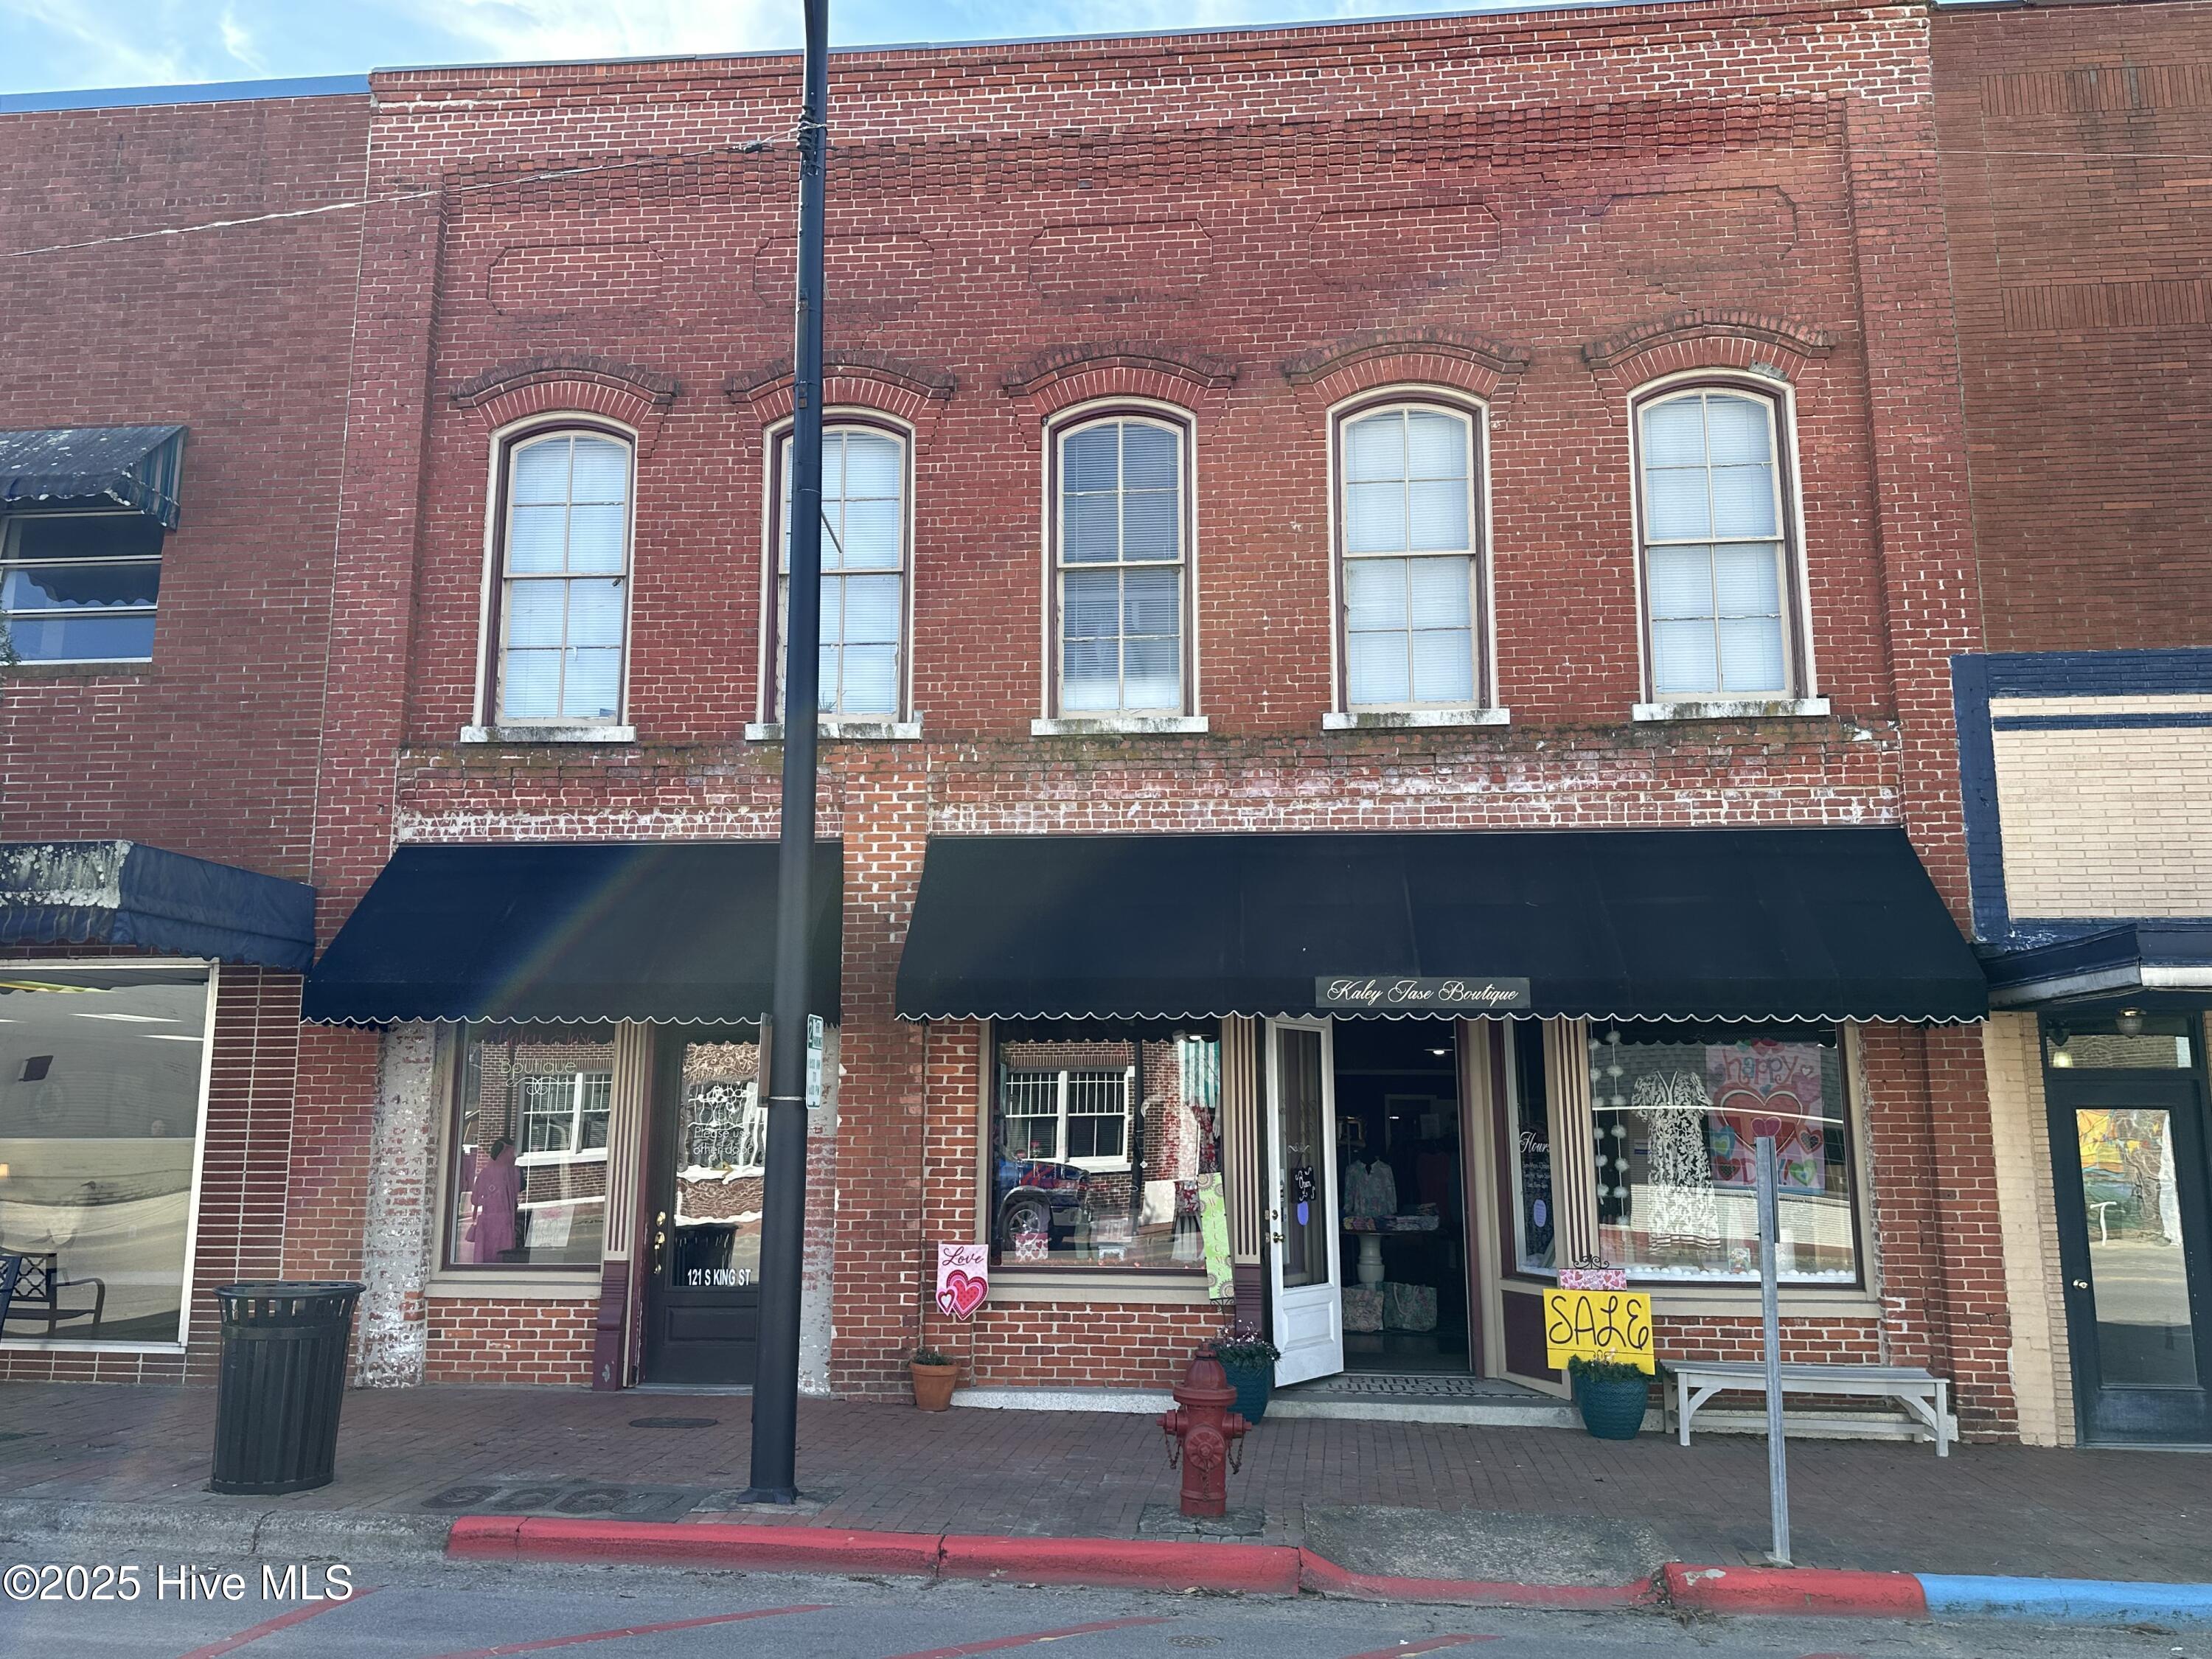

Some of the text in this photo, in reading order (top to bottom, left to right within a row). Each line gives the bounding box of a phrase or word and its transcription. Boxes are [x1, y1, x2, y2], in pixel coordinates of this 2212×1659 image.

[1327, 979, 1383, 1006] Kaley
[1438, 980, 1519, 1007] Boutique
[501, 1058, 577, 1076] Boutique
[1722, 1048, 1799, 1088] happy
[695, 1127, 730, 1138] Please
[693, 1142, 753, 1155] other door
[942, 1246, 984, 1266] Love
[687, 1268, 751, 1286] 121 S KING ST
[1549, 1295, 1649, 1351] SALE
[1347, 1377, 1433, 1385] BANK
